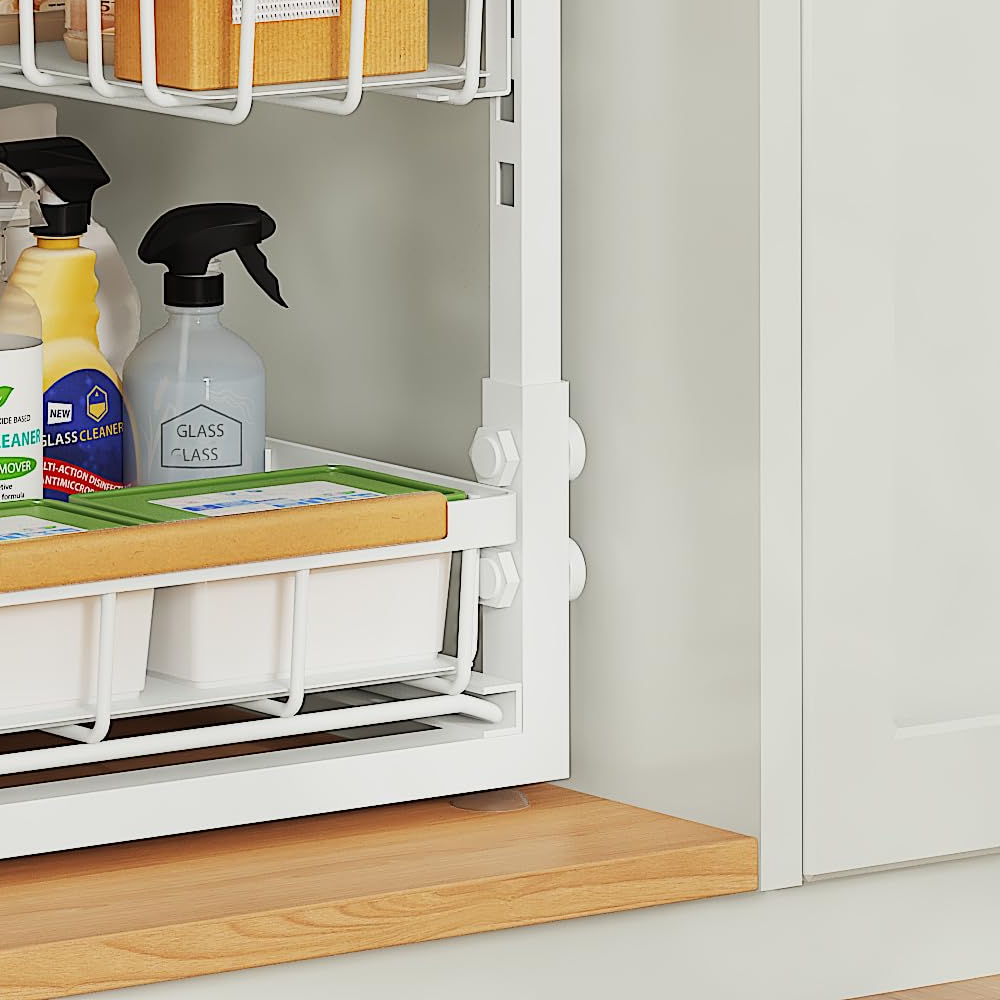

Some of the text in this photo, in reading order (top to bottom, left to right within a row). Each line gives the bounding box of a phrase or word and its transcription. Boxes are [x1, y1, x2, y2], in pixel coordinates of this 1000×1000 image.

[13, 414, 31, 424] BASED
[49, 409, 71, 418] NEW
[79, 421, 124, 442] CLEANER
[176, 424, 224, 438] GLASS
[43, 461, 89, 482] LTI-ACTION
[43, 475, 95, 493] NTIMICCRO
